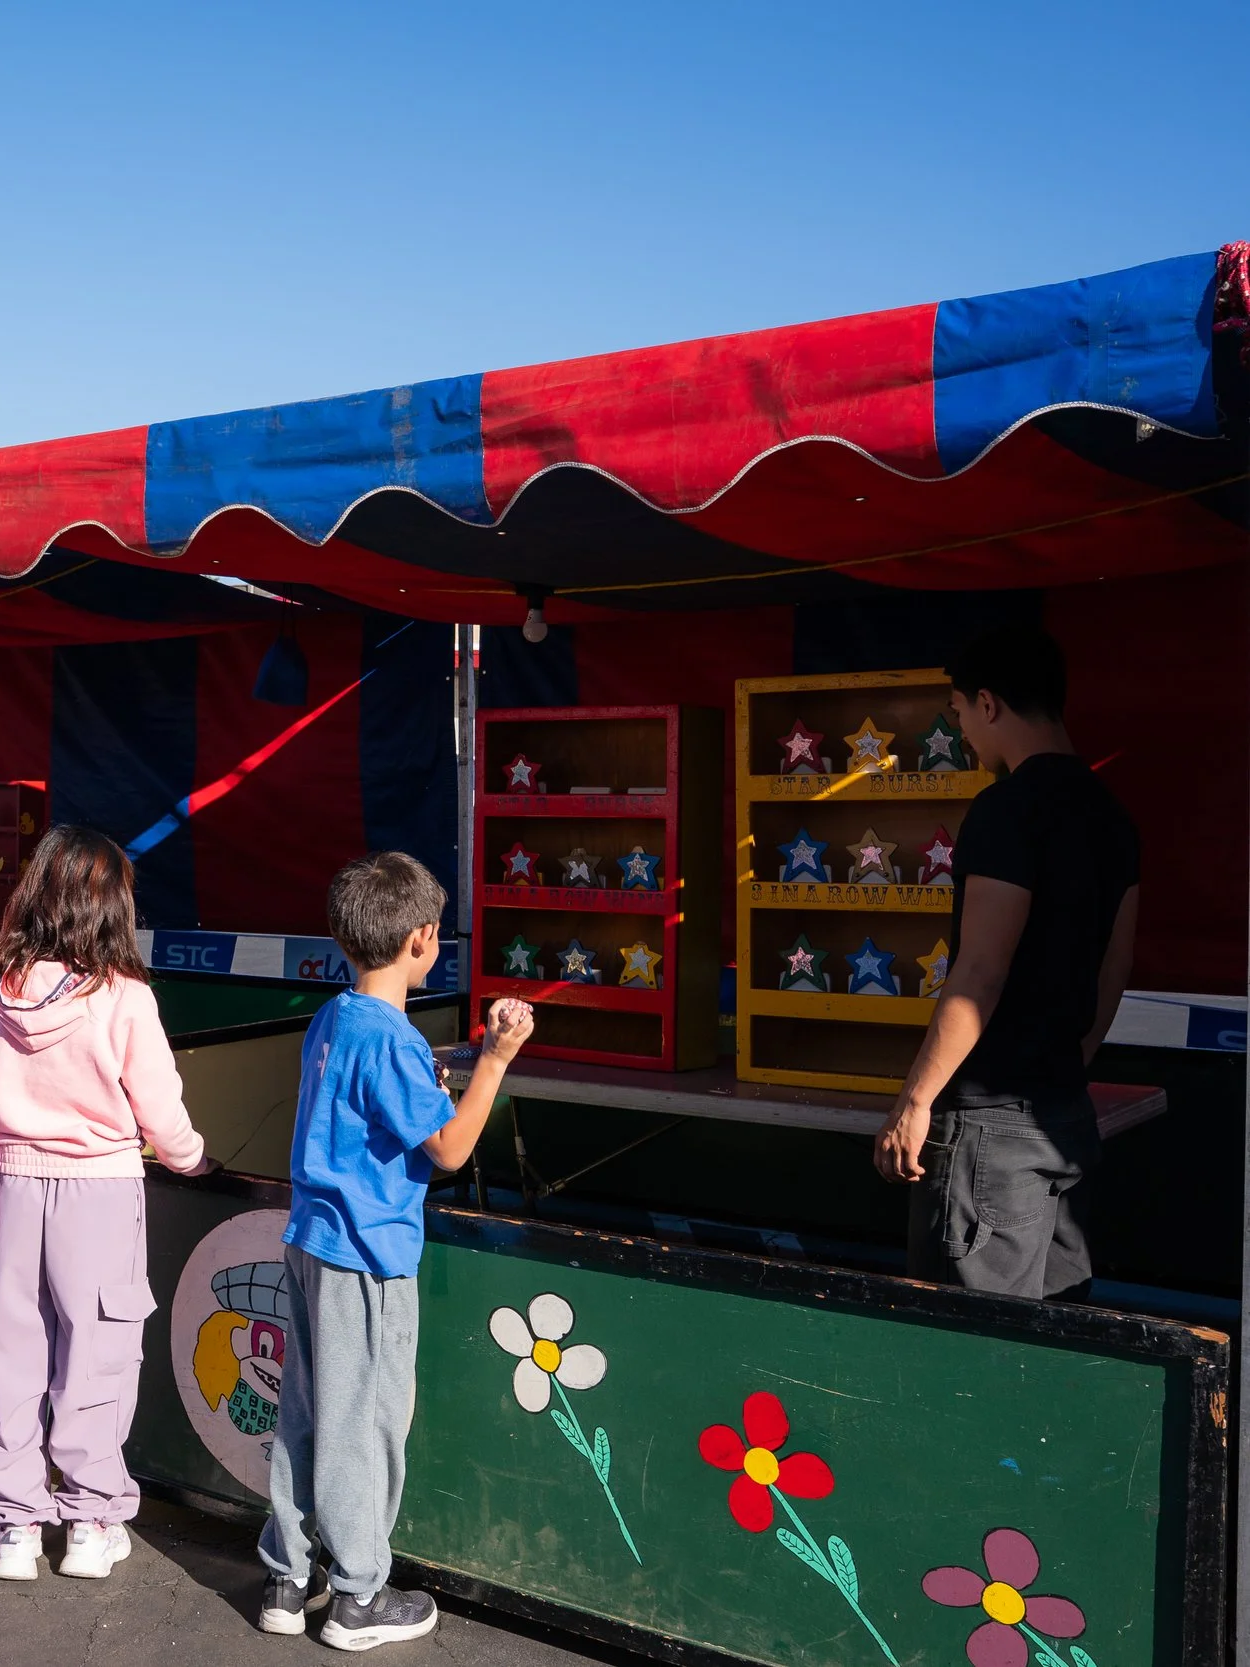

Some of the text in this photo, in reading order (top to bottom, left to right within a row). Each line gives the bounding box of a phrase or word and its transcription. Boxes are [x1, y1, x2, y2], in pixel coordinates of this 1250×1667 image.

[770, 773, 954, 796] STAR BURST
[770, 884, 799, 903] IN
[805, 884, 822, 903] A
[827, 885, 889, 905] ROW
[167, 944, 218, 967] STC
